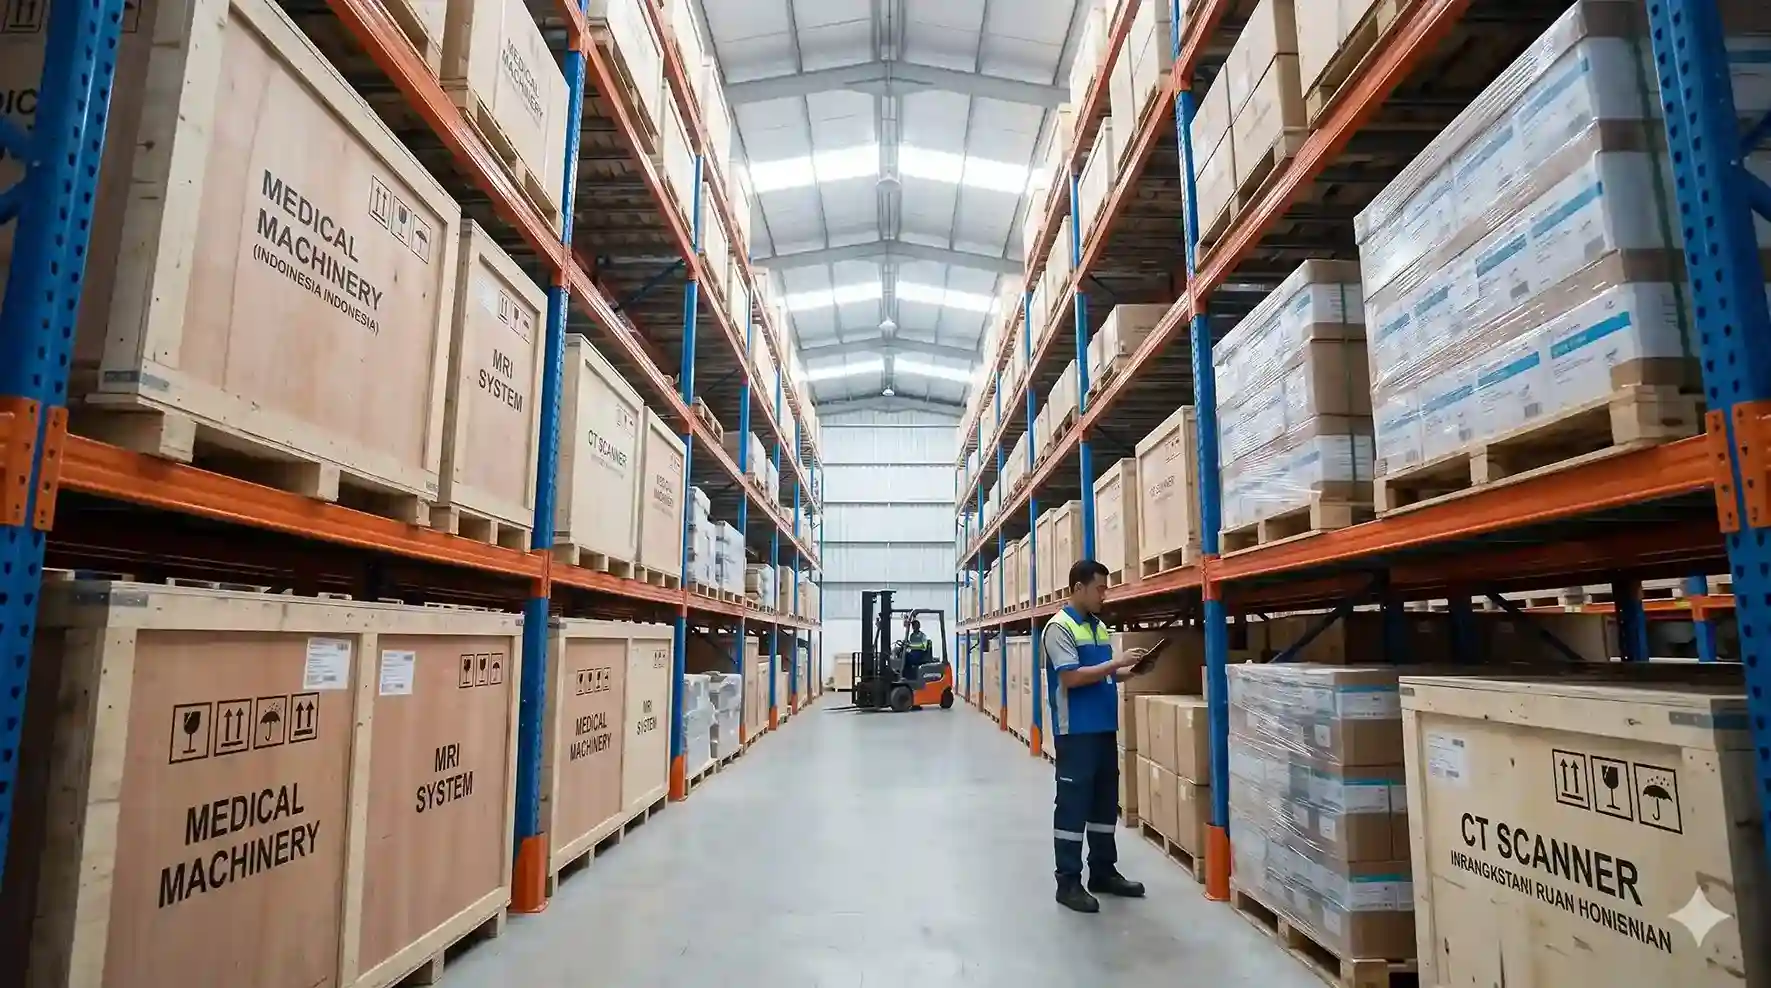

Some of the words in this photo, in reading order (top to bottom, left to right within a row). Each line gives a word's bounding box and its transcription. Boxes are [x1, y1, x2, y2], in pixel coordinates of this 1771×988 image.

[0, 88, 37, 115] IC
[262, 168, 359, 263] MEDICAL
[257, 207, 383, 311] MACHINERY
[252, 243, 322, 299] (INDOINESIA
[323, 288, 380, 336] INDONESIA)
[492, 348, 514, 380] MRI
[478, 368, 523, 413] SYSTEM
[588, 429, 598, 449] CT
[575, 711, 607, 736] MEDICAL
[434, 743, 460, 773] MRI
[569, 732, 612, 761] MACHINERY
[185, 782, 304, 846] MEDICAL
[415, 771, 473, 813] SYSTEM
[158, 819, 321, 909] MACHINERY
[1450, 850, 1532, 896] INRANGKSTANI
[1536, 881, 1575, 914] RUAN
[1461, 812, 1489, 851] CT
[1497, 822, 1643, 907] SCANNER
